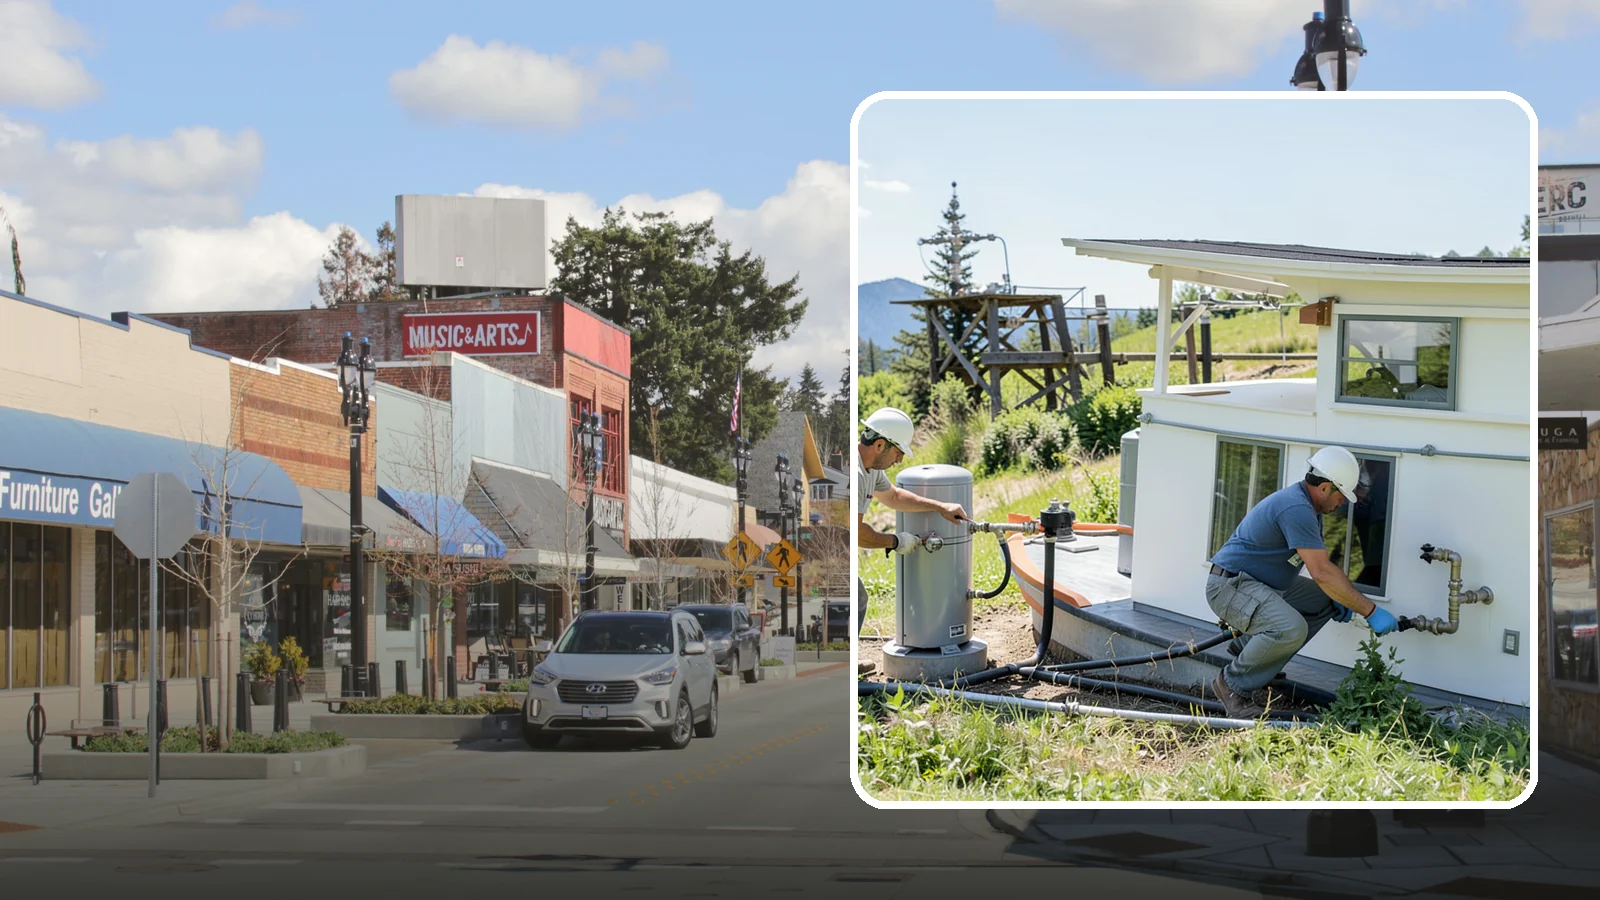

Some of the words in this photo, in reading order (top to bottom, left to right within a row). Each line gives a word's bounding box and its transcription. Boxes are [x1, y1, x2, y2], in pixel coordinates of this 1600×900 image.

[408, 323, 524, 349] MUSIC&ARTS
[0, 472, 79, 516] Furniture
[90, 483, 122, 519] Gal
[454, 563, 480, 574] SUSHI
